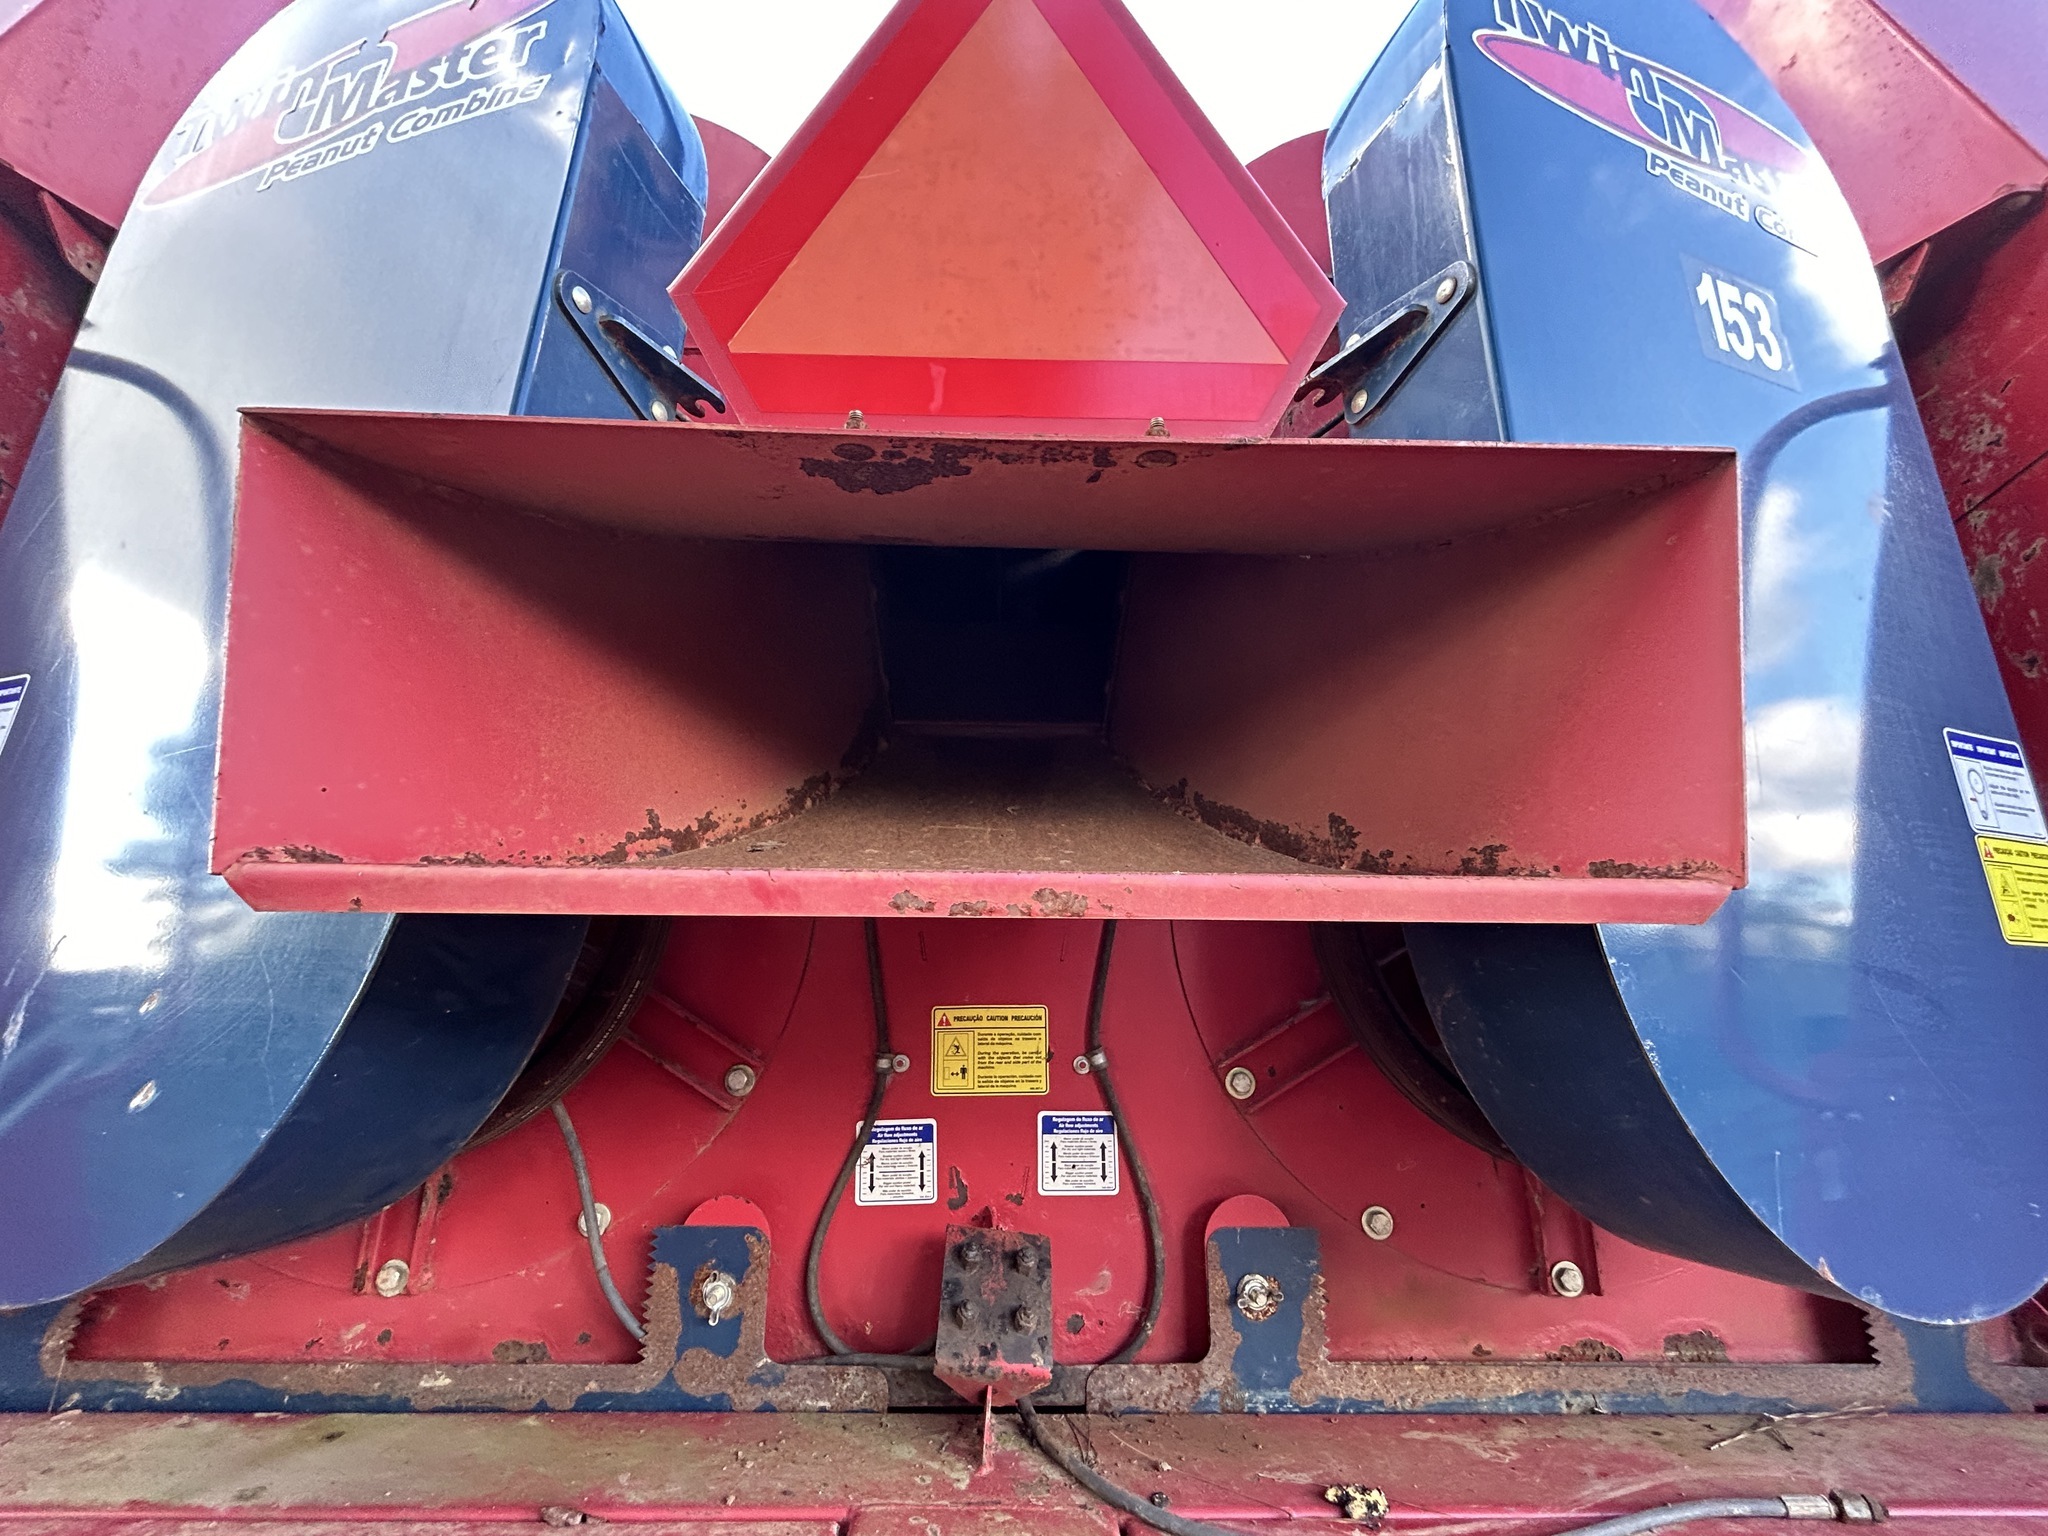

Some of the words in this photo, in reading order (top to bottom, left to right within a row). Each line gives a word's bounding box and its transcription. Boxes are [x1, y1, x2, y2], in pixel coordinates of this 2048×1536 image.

[308, 22, 547, 135] Master
[259, 124, 382, 190] Peanut
[390, 77, 546, 141] Combine
[1649, 152, 1749, 219] Peanut
[1696, 272, 1783, 371] 153
[954, 1014, 983, 1022] PRECAUÇÃO
